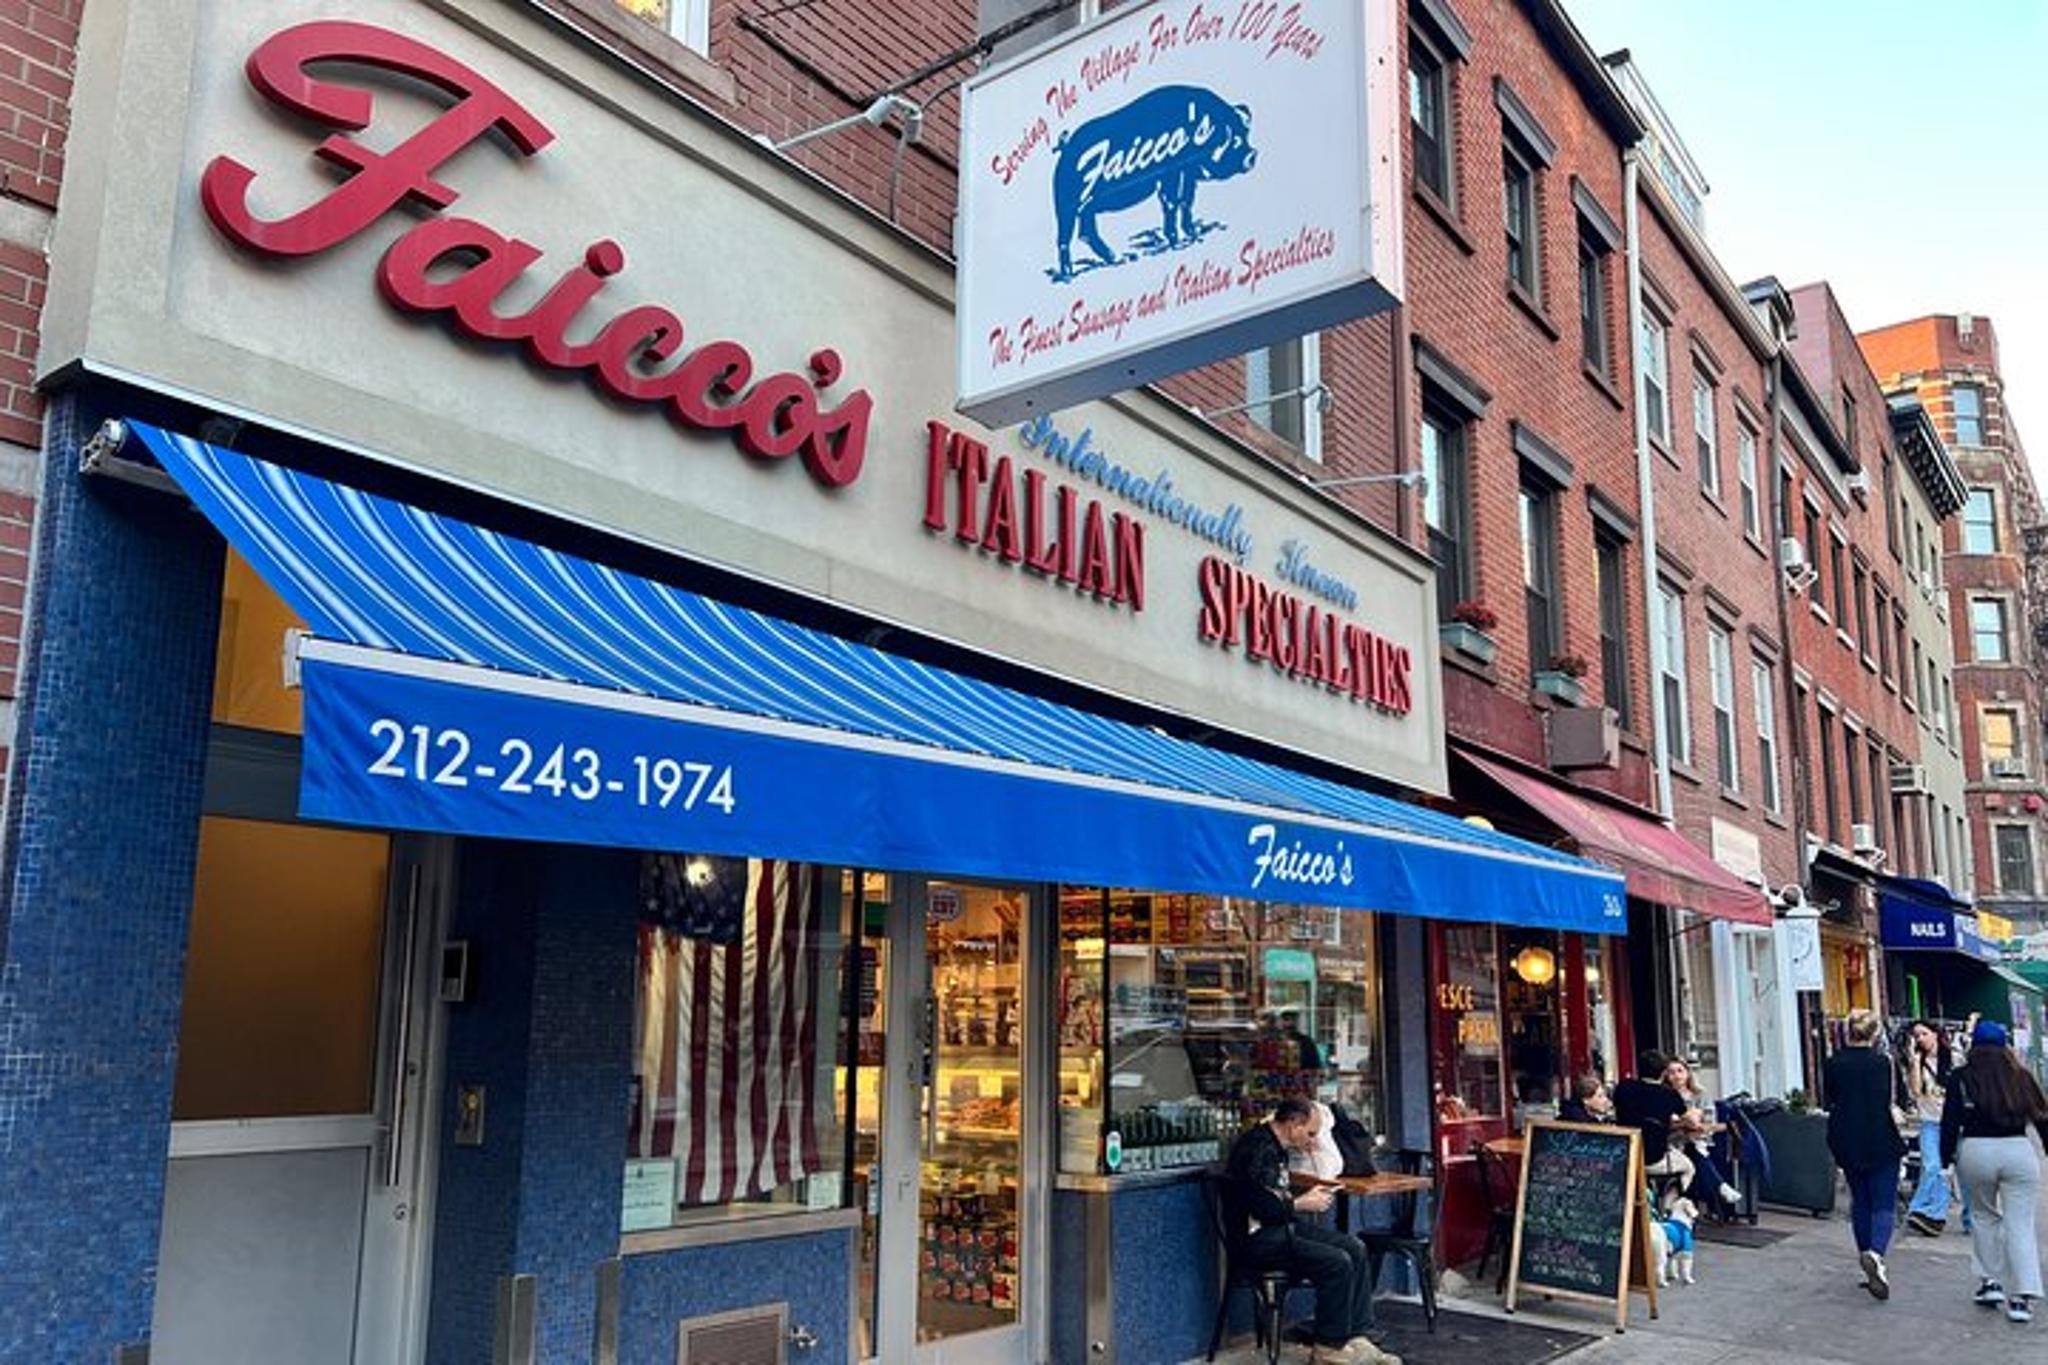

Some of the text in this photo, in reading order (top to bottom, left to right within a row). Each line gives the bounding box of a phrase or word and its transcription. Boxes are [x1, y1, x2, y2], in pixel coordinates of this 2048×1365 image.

[992, 2, 1325, 185] Serving The Village For Over 100 Years
[1077, 102, 1216, 202] Faicco's
[201, 20, 873, 487] Faicco's
[989, 223, 1336, 369] The Finest Sausage and Italian Specialties
[1020, 415, 1252, 563] Internationally
[922, 420, 1413, 716] ITALIAN SPECIALTIES
[367, 718, 735, 814] 212-243-1974
[1248, 824, 1354, 889] Faicco's
[1910, 922, 1946, 937] NAILS
